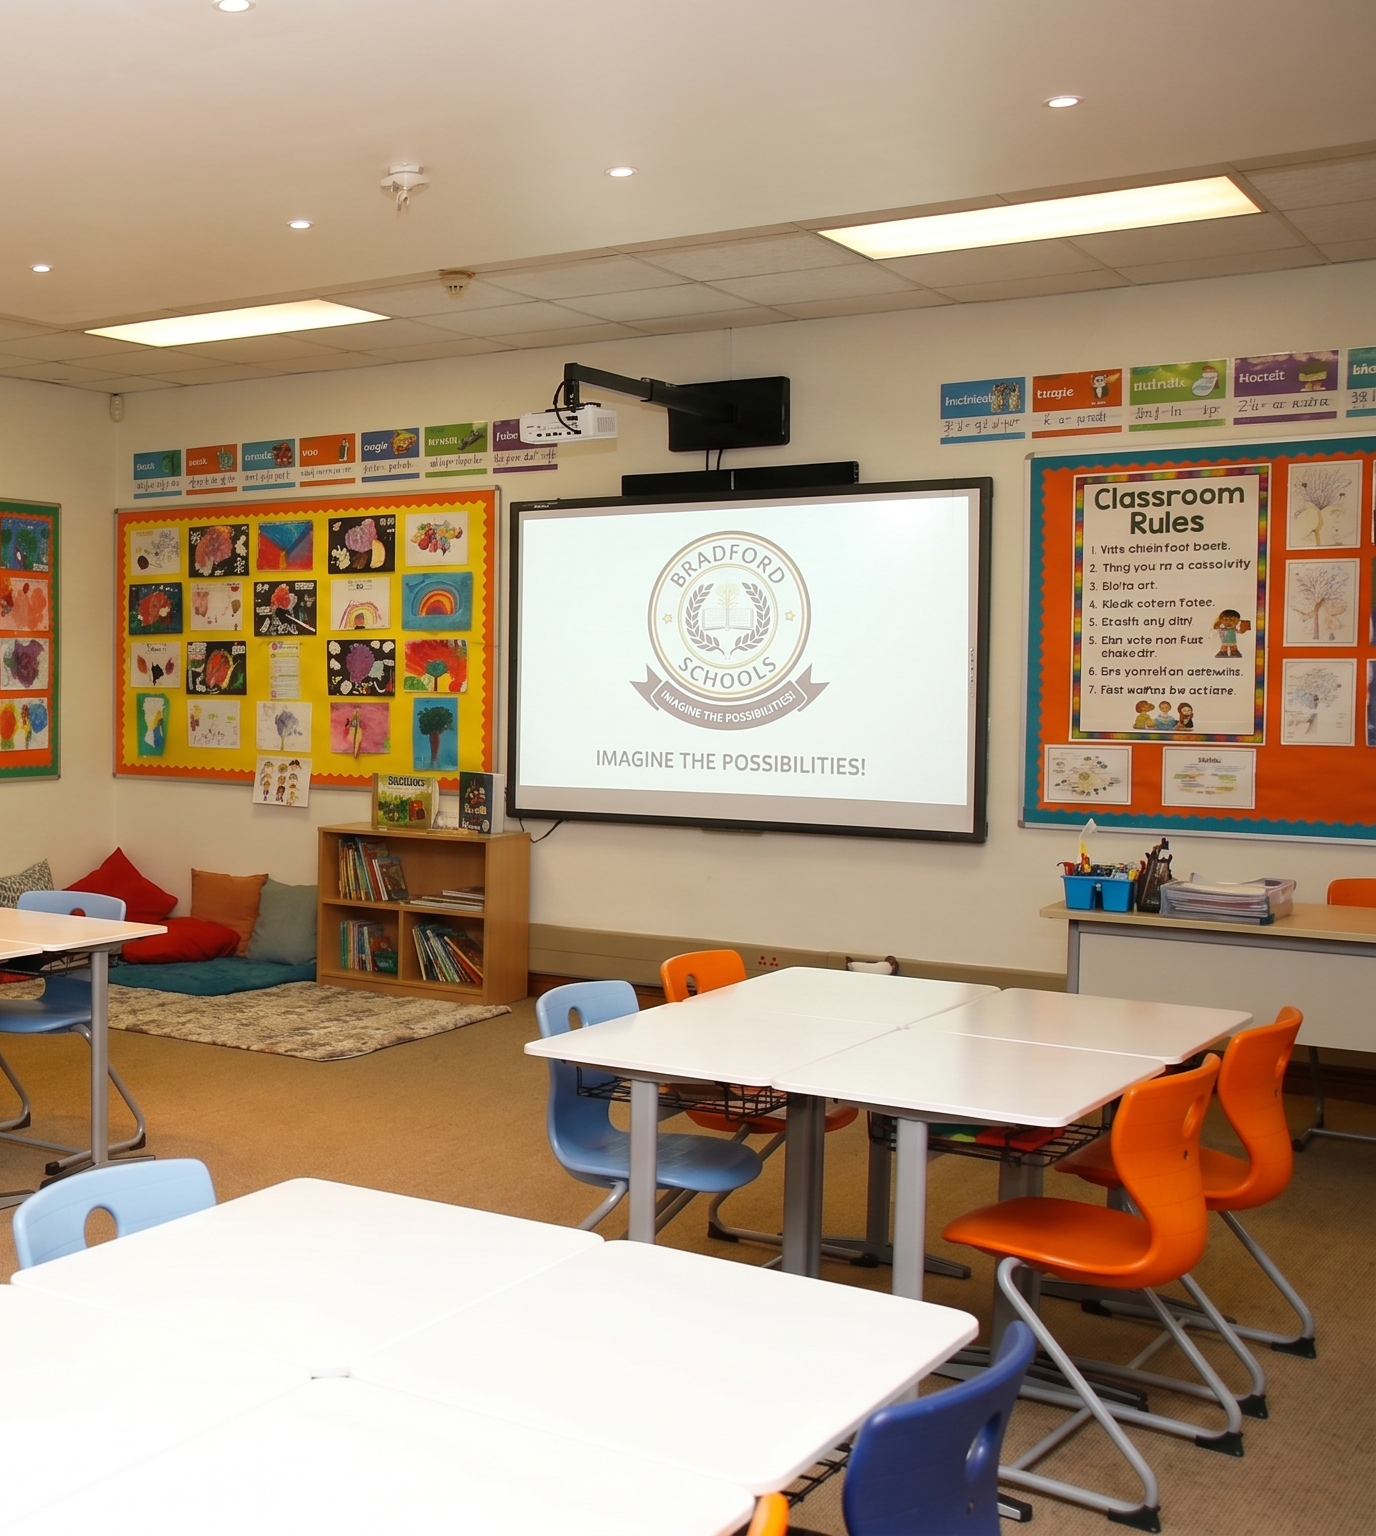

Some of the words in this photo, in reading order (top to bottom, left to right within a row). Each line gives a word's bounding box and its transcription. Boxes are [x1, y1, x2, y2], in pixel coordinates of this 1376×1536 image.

[1094, 486, 1244, 510] Classroom
[1130, 511, 1204, 534] Rules
[670, 544, 786, 588] BRADFORD
[1090, 564, 1097, 572] 2.
[1176, 562, 1184, 570] a
[1090, 583, 1097, 591] 3.
[1089, 600, 1097, 609] 4.
[1089, 618, 1097, 626] 5.
[1089, 636, 1097, 644] 5.
[678, 656, 776, 688] SCHOOLS
[1089, 667, 1097, 675] 6.
[1089, 686, 1096, 694] 7.
[704, 711, 723, 723] THE
[597, 750, 674, 768] IMAGINE
[679, 752, 716, 770] THE
[723, 754, 866, 776] POSSIBILITIES!
